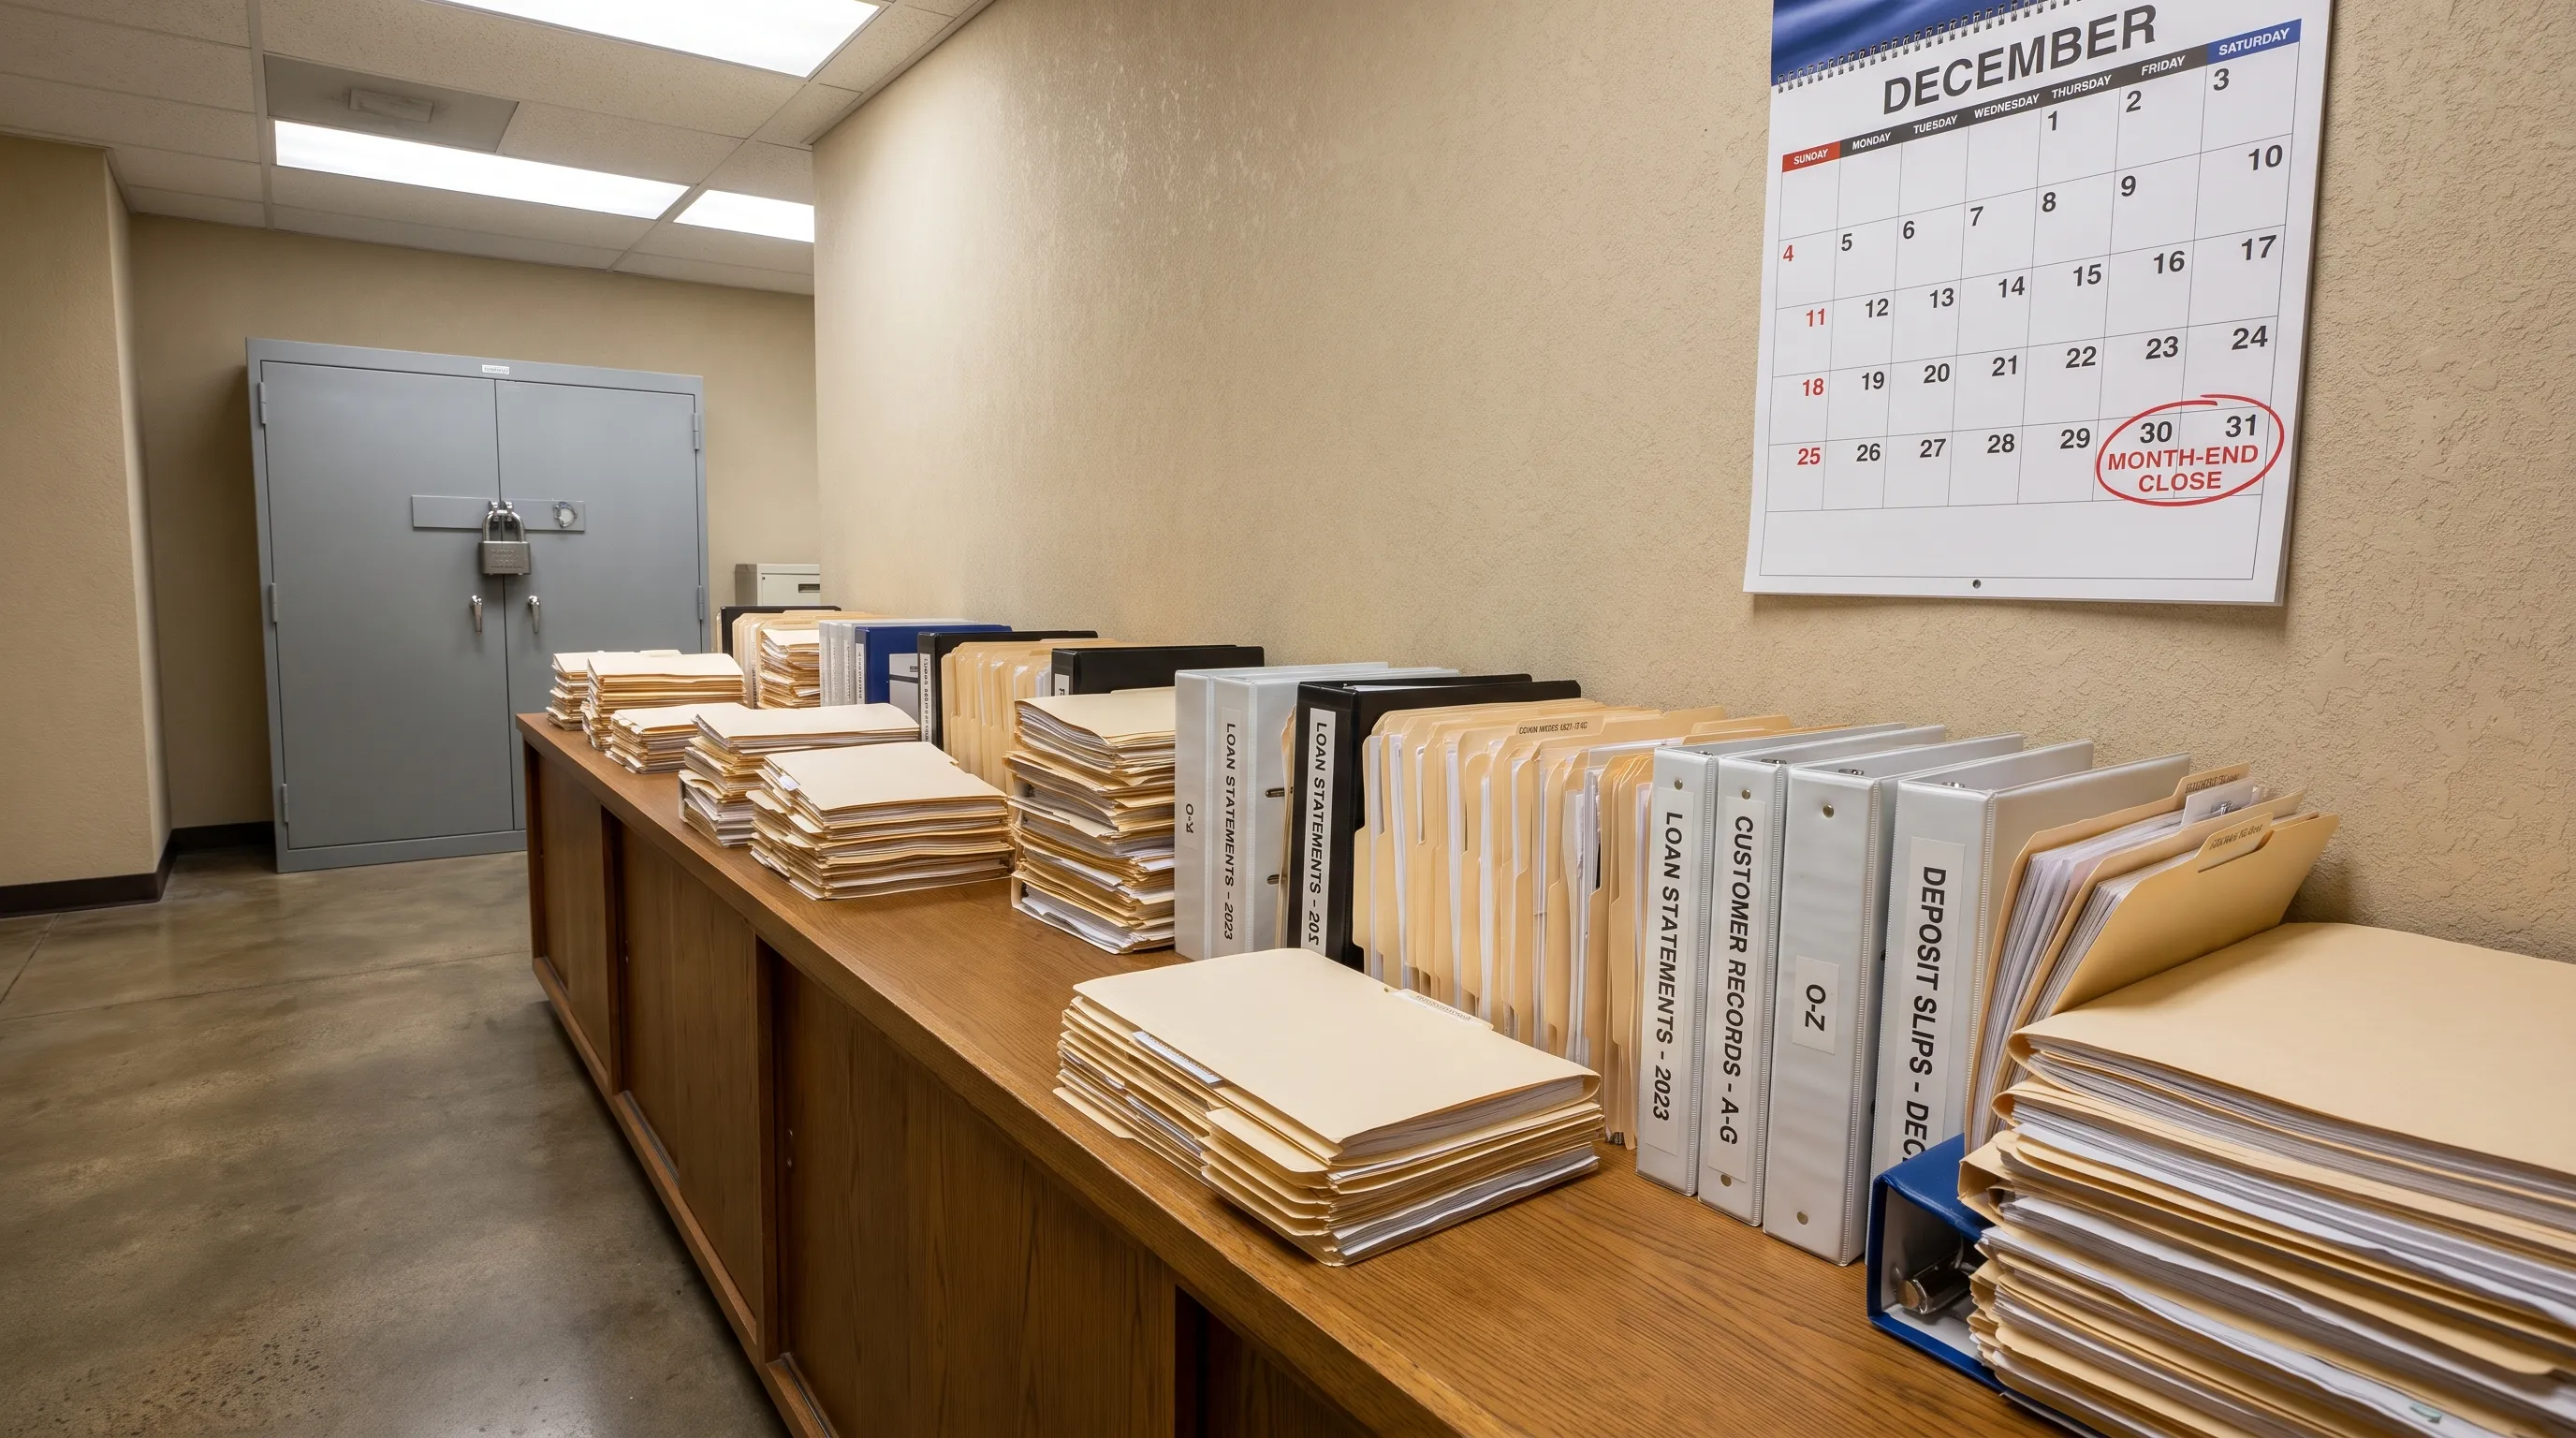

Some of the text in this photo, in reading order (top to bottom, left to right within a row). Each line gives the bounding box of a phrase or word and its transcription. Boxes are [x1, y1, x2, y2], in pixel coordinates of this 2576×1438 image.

[1883, 4, 2157, 115] DECEMBER
[1794, 28, 2290, 164] SUNDAY MONDAY TUESDAY WEDNESDAY THURSDAY FRIDAY SATURDAY
[2048, 68, 2229, 131] 1 2 3
[1782, 145, 2282, 260] 4 5 6 7 8 9 10
[1808, 234, 2277, 326] 11 12 13 14 15 16 17
[1803, 326, 2268, 397] 18 19 20 21 22 23 24
[1797, 415, 2256, 466] 25 26 27 28 29 30 31
[2108, 444, 2259, 470] MONTH-END
[2139, 471, 2220, 492] CLOSE
[1227, 724, 1236, 770] LOAN
[1315, 723, 1326, 770] LOAN
[1225, 776, 1235, 887] STATEMENTS
[1310, 777, 1325, 893] STATEMENTS
[1664, 812, 1682, 879] LOAN
[1730, 816, 1753, 952] CUSTOMER
[1224, 902, 1233, 940] 2023
[1916, 867, 1946, 990] DEPOSIT
[1657, 887, 1679, 1044] STATEMENTS
[1723, 960, 1746, 1077] RECORDS
[1805, 985, 1825, 1031] O-Z
[1910, 996, 1937, 1075] SLIPS
[1653, 1065, 1671, 1121] 2023
[1720, 1097, 1738, 1144] A-G
